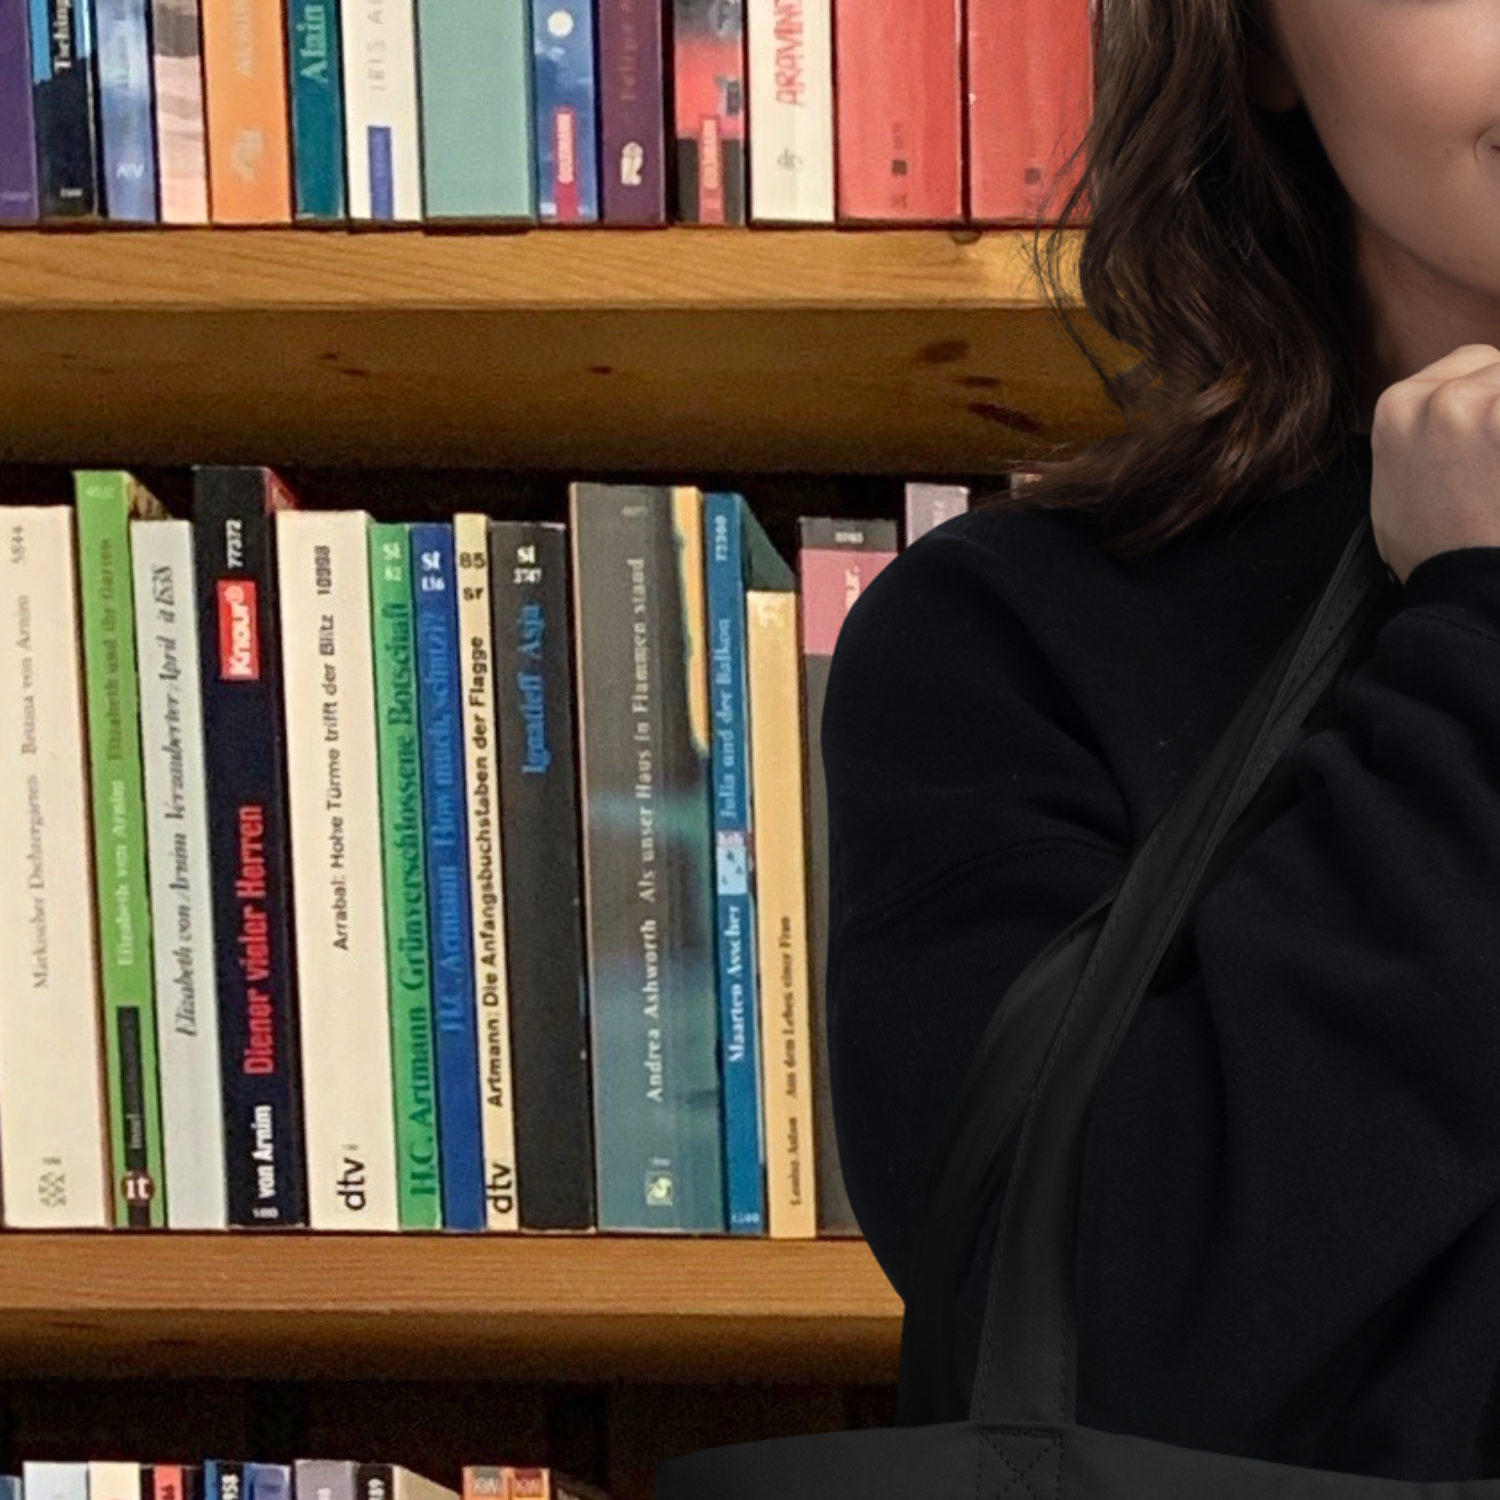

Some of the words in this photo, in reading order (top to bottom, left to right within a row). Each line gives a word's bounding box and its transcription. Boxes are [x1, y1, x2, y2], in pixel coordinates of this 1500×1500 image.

[297, 3, 328, 81] Alain
[627, 559, 645, 613] stand
[320, 615, 334, 656] Blitz
[322, 664, 337, 696] der
[469, 637, 487, 707] Flagge
[632, 623, 648, 712] Flammen
[321, 700, 340, 743] trifft
[473, 715, 487, 749] der
[634, 723, 649, 740] in
[326, 749, 342, 810] Türme
[636, 750, 651, 799] Haus
[236, 807, 265, 897] Herren
[330, 817, 344, 868] Hohe
[639, 806, 654, 861] unser
[475, 757, 500, 966] Anfangsbuchstaben
[639, 871, 654, 901] Als
[331, 876, 350, 950] Arrabal:
[238, 905, 269, 980] vieler
[483, 973, 498, 1007] Die
[641, 920, 659, 1020] Ashworth
[244, 989, 273, 1073] Diener
[645, 1029, 662, 1101] Andrea
[252, 1106, 272, 1161] Arnim
[258, 1166, 274, 1197] von
[337, 1158, 366, 1211] dtv
[487, 1163, 512, 1213] dtv
